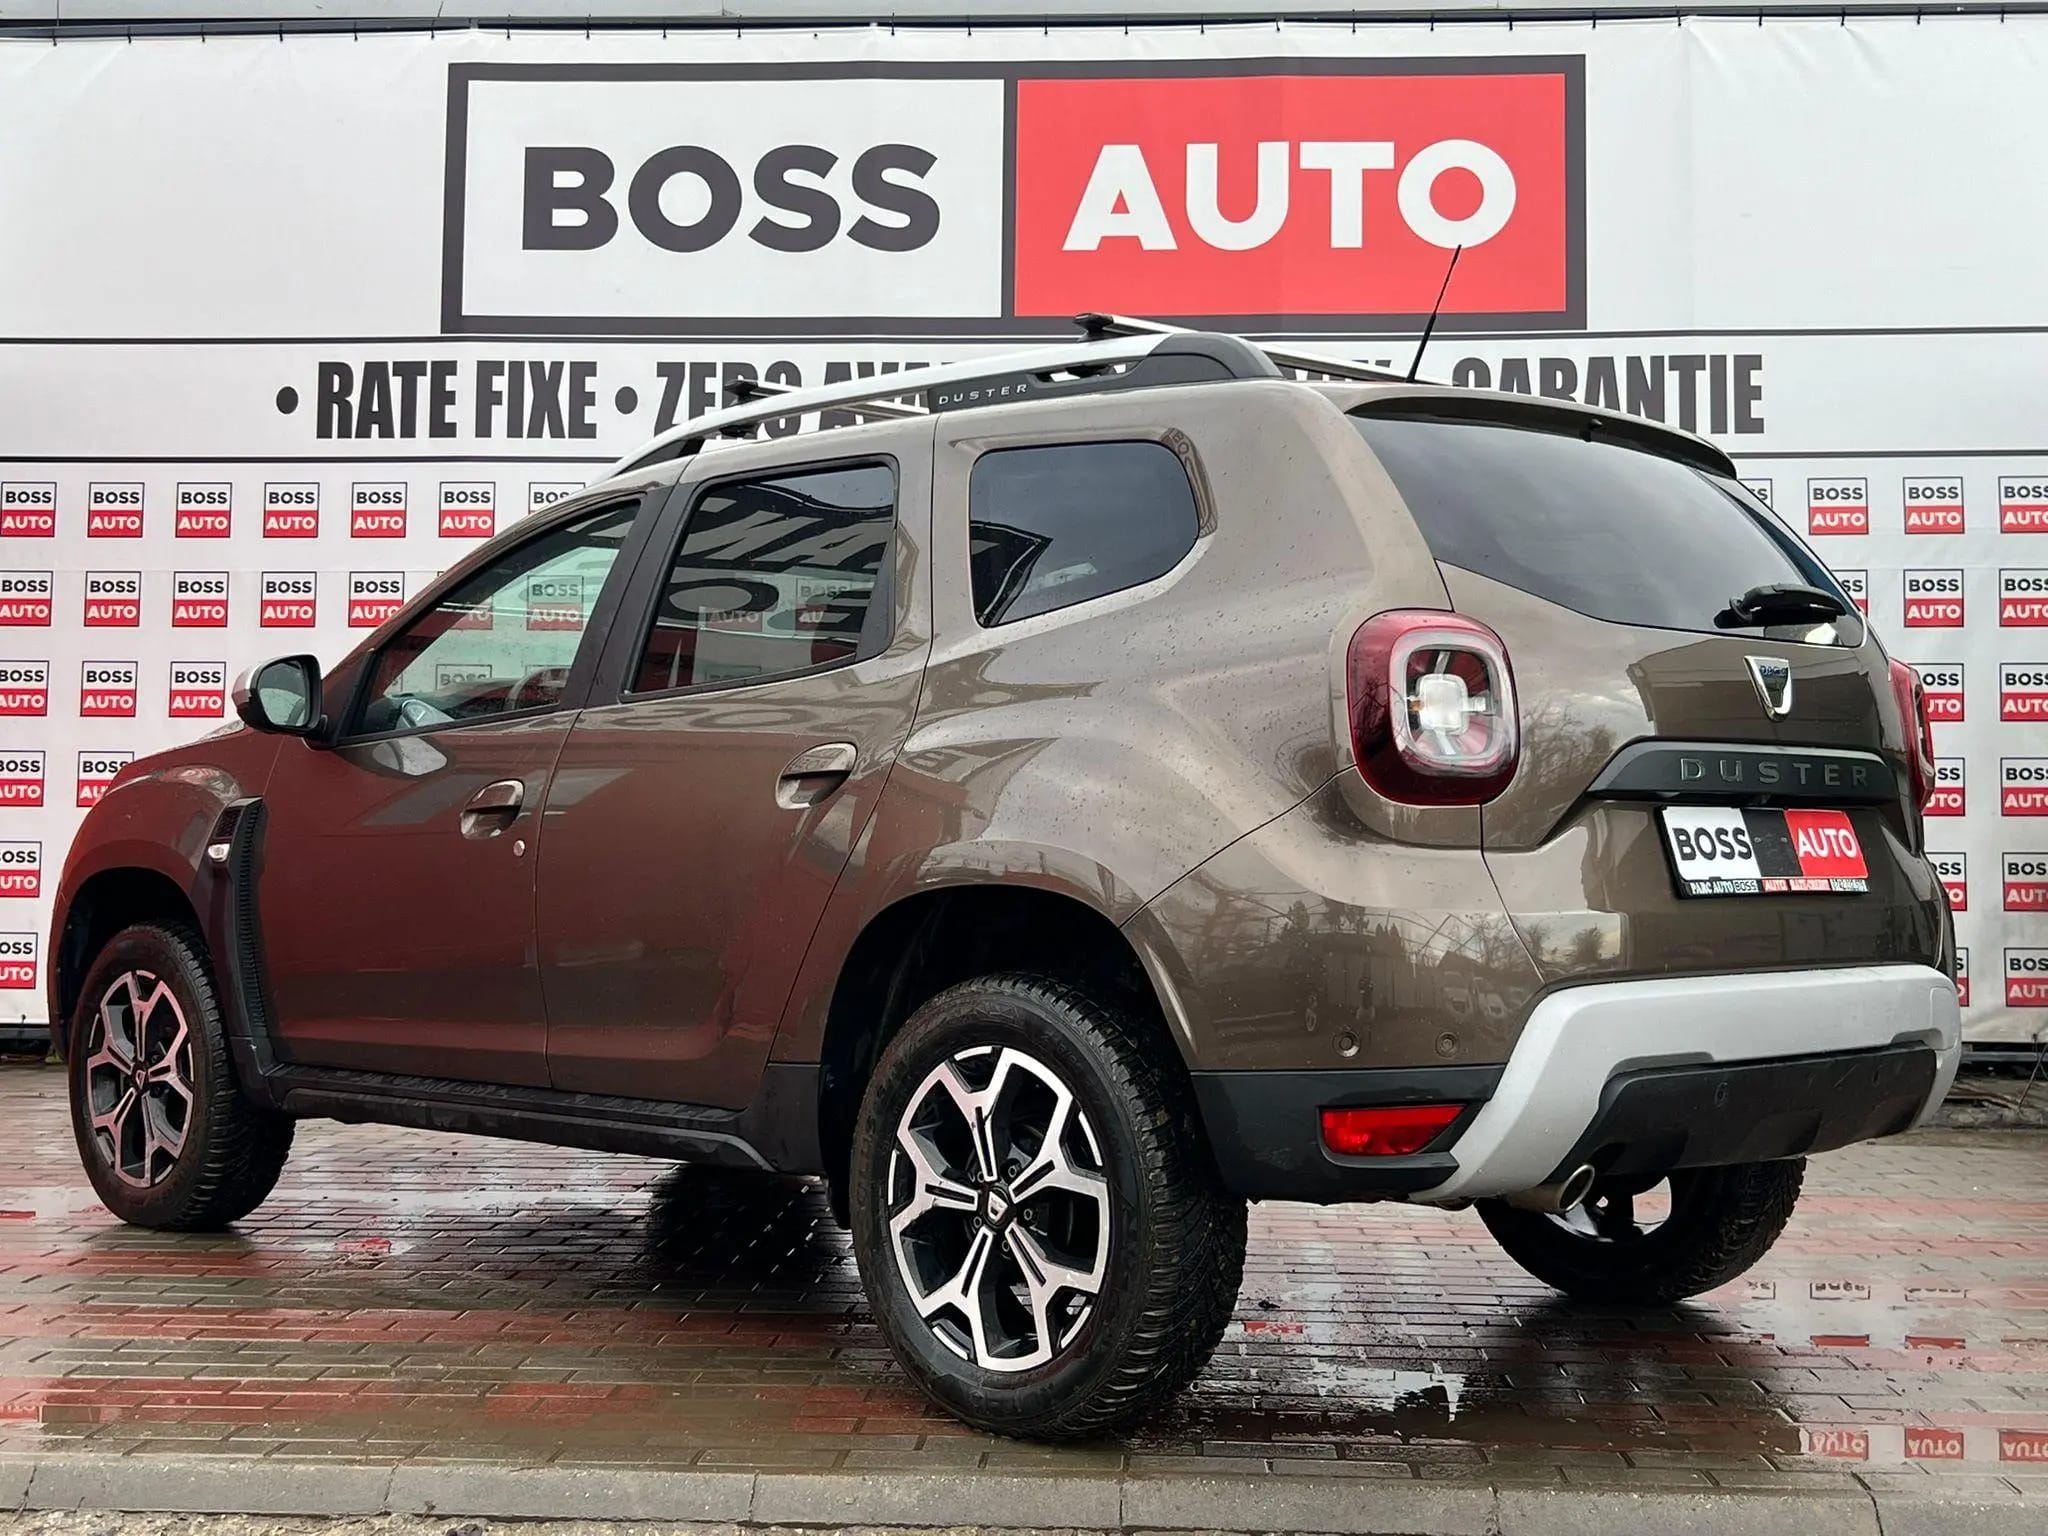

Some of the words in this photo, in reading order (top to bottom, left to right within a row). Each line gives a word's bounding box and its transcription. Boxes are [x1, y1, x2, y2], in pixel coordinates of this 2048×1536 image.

[523, 143, 939, 252] BOSS
[1063, 138, 1517, 252] AUTO
[316, 360, 458, 440] RATE
[474, 360, 597, 439] FIXE
[938, 383, 1028, 406] DUSTER
[5, 491, 52, 504] BOSS
[93, 491, 140, 504] BOSS
[181, 491, 228, 504] BOSS
[268, 491, 315, 504] BOSS
[356, 491, 403, 504] BOSS
[444, 491, 491, 504] BOSS
[533, 491, 571, 504] BOS
[1813, 487, 1863, 501] BOSS
[1908, 486, 1959, 500] BOSS
[2, 516, 52, 530] AUTO
[90, 516, 141, 530] AUTO
[178, 516, 228, 530] AUTO
[266, 516, 316, 530] AUTO
[354, 516, 403, 530] AUTO
[442, 516, 492, 530] AUTO
[1812, 512, 1865, 527] AUTO
[1908, 511, 1961, 526] AUTO
[2, 580, 48, 593] BOSS
[90, 580, 136, 593] BOSS
[178, 580, 224, 593] BOSS
[265, 580, 313, 593] BOSS
[354, 581, 400, 594] BOSS
[532, 584, 579, 597] BOSS
[1908, 579, 1959, 592] BOSS
[0, 605, 48, 619] AUTO
[87, 605, 137, 619] AUTO
[175, 605, 225, 619] AUTO
[263, 605, 313, 619] AUTO
[352, 605, 400, 619] AUTO
[1907, 604, 1961, 619] AUTO
[86, 670, 133, 683] BOSS
[174, 671, 221, 684] BOSS
[1922, 673, 1959, 687] OSS
[83, 695, 134, 709] AUTO
[172, 695, 222, 709] AUTO
[1927, 698, 1961, 713] UTO
[1680, 757, 1869, 787] DUSTER
[1937, 767, 1961, 781] SS
[2005, 767, 2048, 781] BOS
[1926, 793, 1962, 808] UTO
[1672, 826, 1753, 861] BOSS
[1798, 826, 1858, 860] AUTO
[0, 850, 37, 864] OSS
[2008, 862, 2048, 876] BOS
[0, 875, 38, 890] UTO
[2006, 888, 2048, 904] AUT
[0, 941, 33, 955] OSS
[2009, 957, 2048, 971] BOS
[0, 967, 33, 982] UTO
[2009, 983, 2048, 999] AUT
